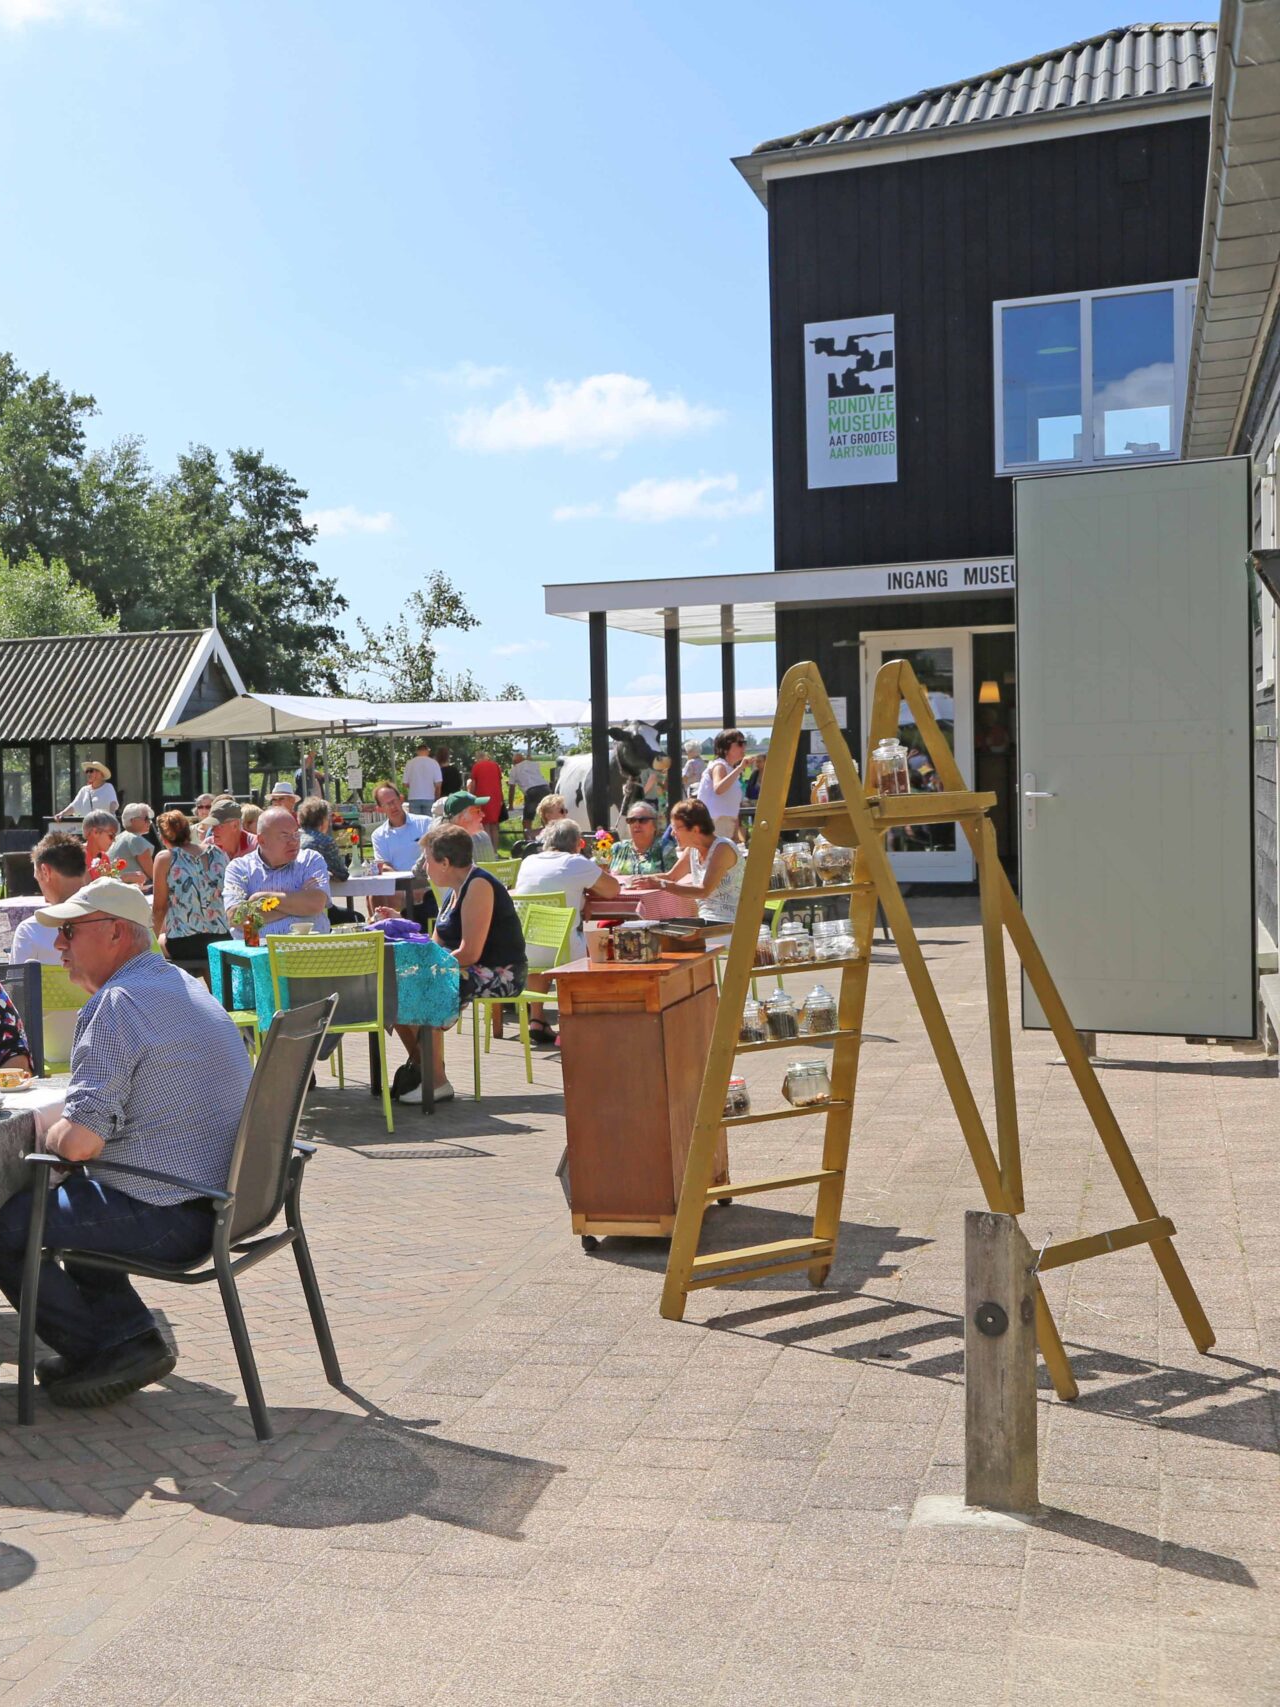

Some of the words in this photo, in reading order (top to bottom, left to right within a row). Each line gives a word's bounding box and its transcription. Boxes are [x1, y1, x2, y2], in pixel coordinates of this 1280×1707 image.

[828, 394, 895, 415] RUNDVEE
[828, 411, 895, 434] MUSEUM
[829, 434, 847, 447] AAT
[850, 430, 895, 445] GROOTES
[830, 442, 896, 459] AARTSWOUD
[887, 569, 949, 590] INGANG
